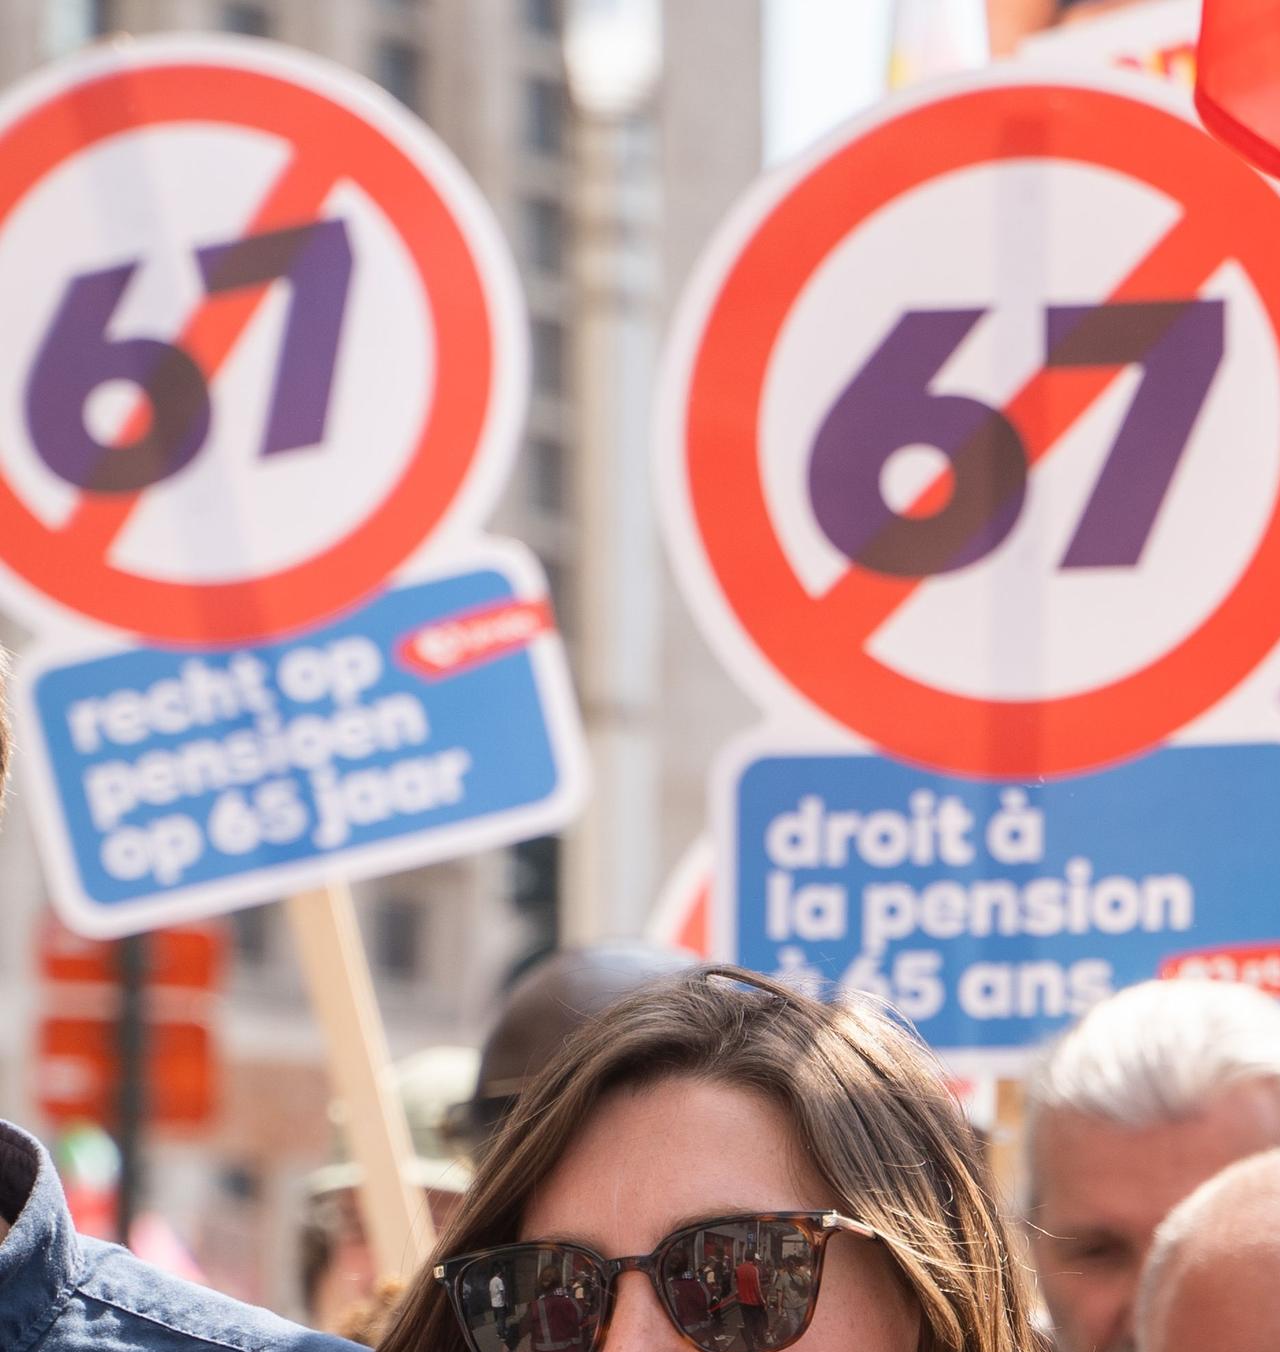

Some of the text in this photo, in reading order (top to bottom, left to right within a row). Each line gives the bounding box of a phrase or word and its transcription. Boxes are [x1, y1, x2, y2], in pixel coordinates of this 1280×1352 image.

[25, 217, 353, 495] 67
[805, 298, 1227, 579] 67
[66, 653, 272, 754] recht
[276, 635, 384, 706] op
[82, 693, 430, 831] pensioen
[101, 747, 472, 886] op 65 jaar
[765, 789, 1046, 868] droit à
[765, 857, 1195, 955] la pension
[957, 958, 1117, 1021] ans
